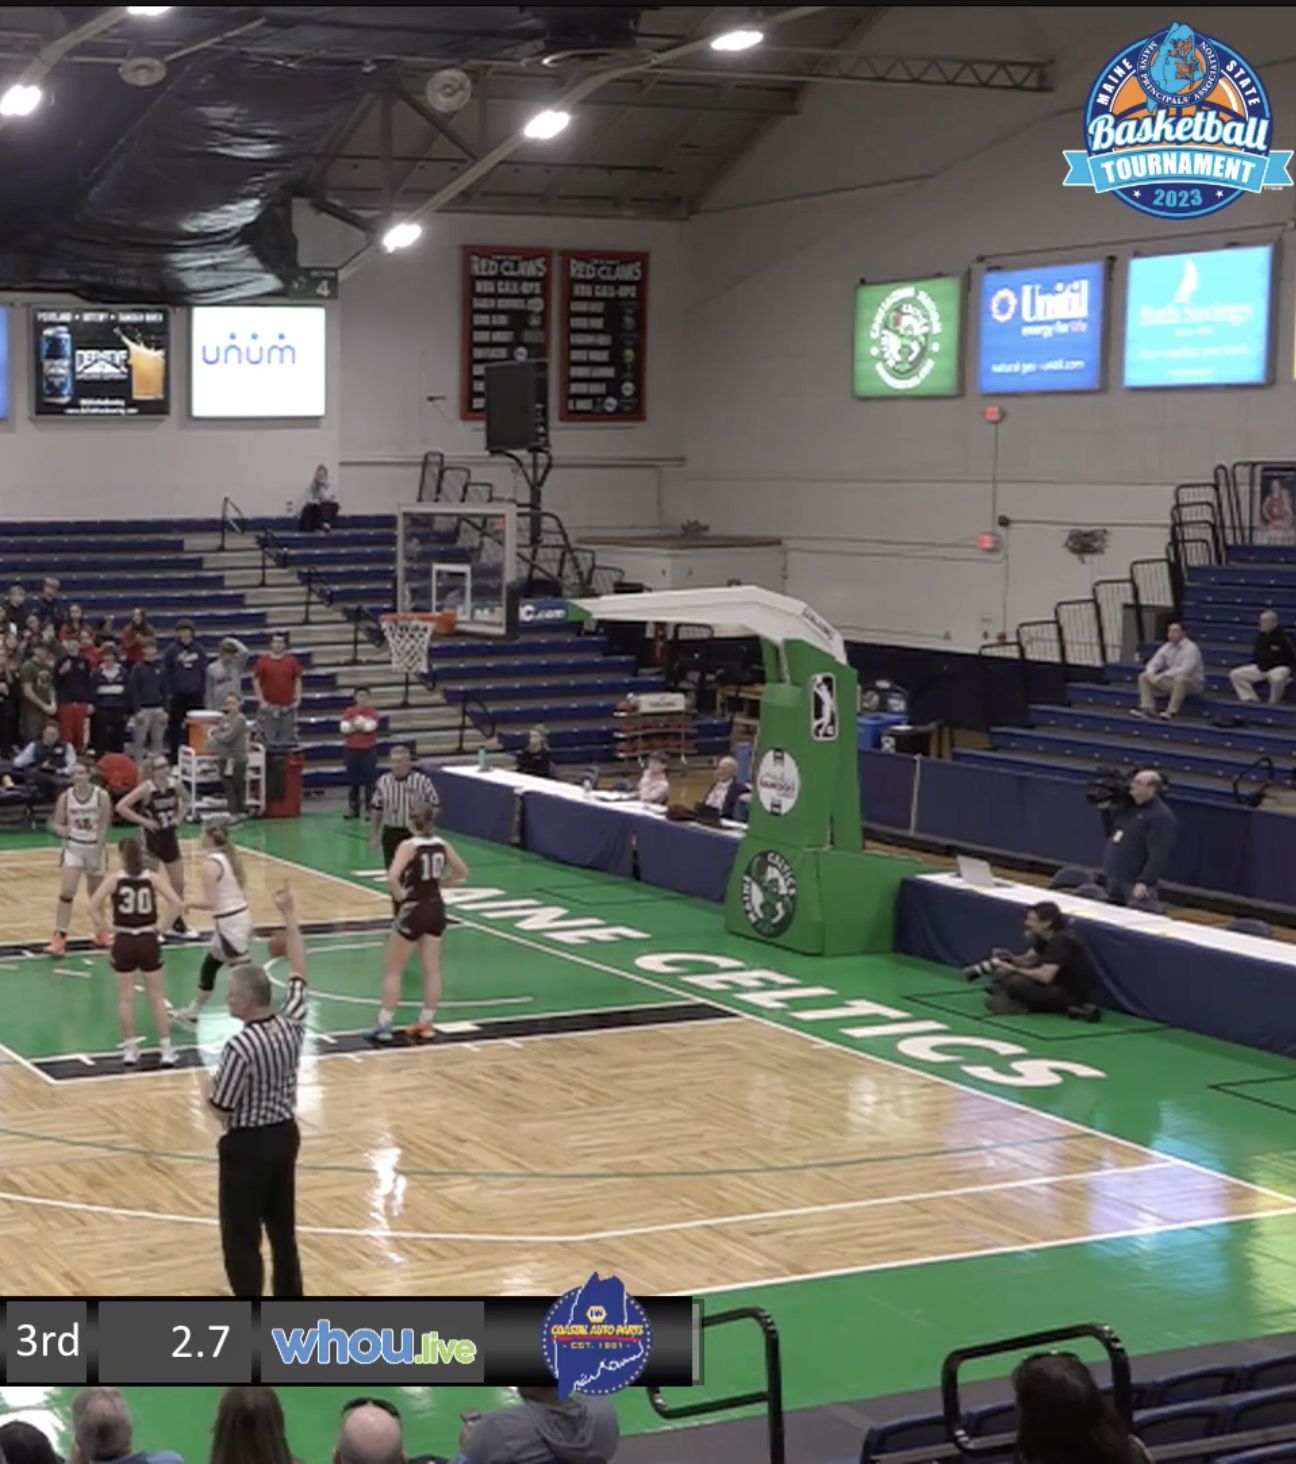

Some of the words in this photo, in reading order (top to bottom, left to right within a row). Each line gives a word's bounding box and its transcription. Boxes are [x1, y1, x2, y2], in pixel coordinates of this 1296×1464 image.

[470, 255, 499, 276] RED
[500, 257, 547, 278] CLAWS
[569, 258, 596, 279] RED
[315, 279, 331, 298] 4
[202, 344, 295, 364] unum
[421, 852, 445, 881] 10
[118, 887, 152, 915] 30
[634, 952, 1107, 1088] CELTICS
